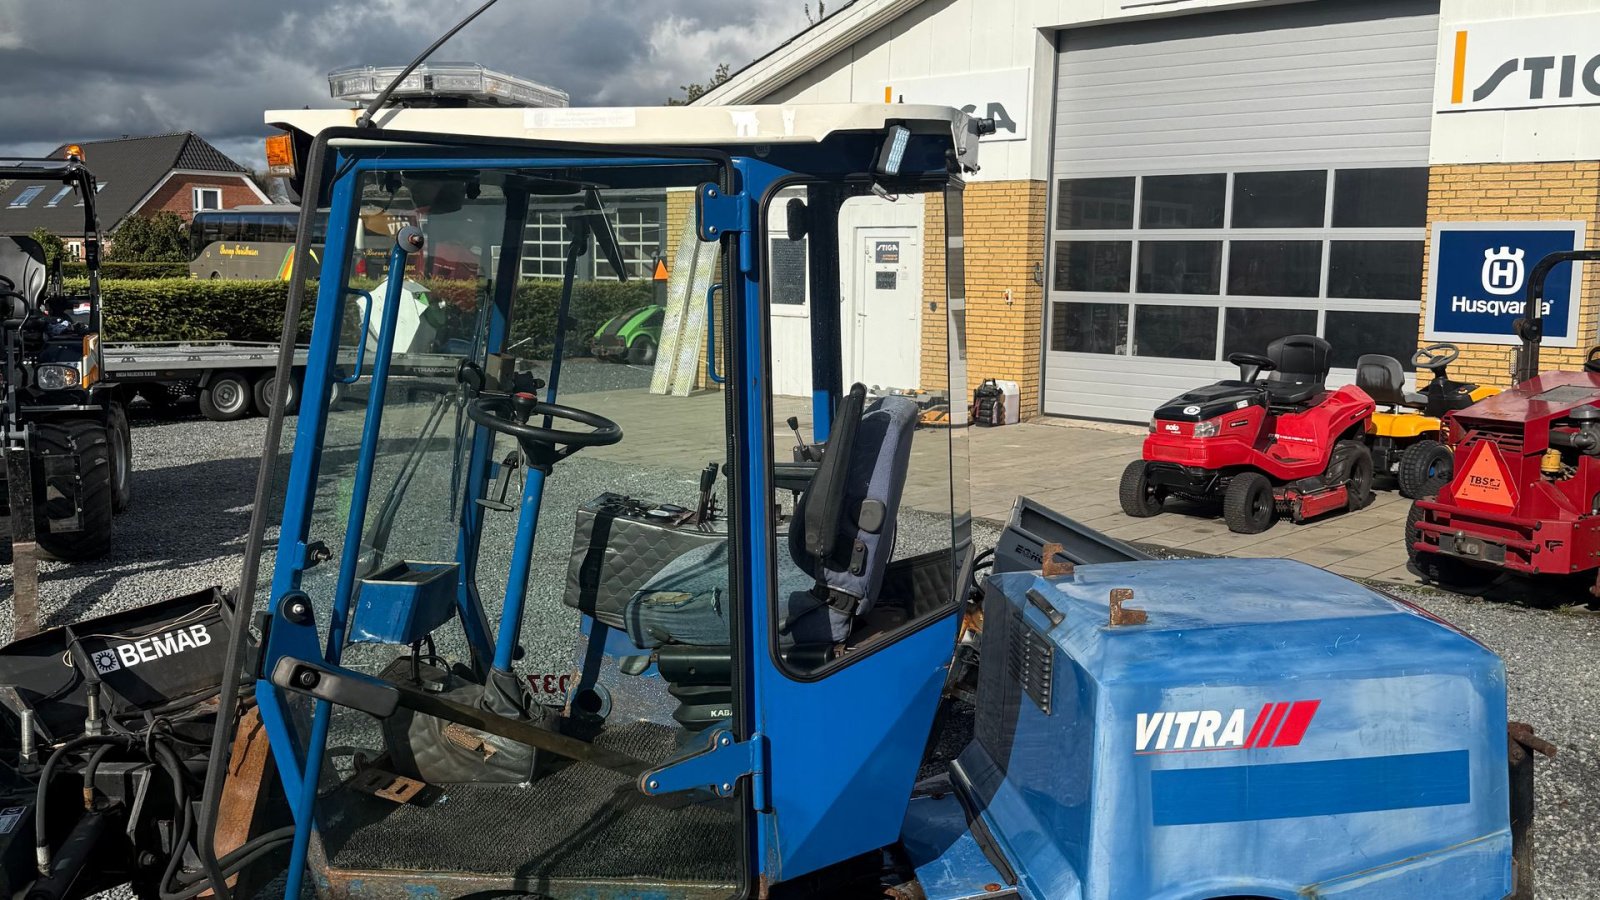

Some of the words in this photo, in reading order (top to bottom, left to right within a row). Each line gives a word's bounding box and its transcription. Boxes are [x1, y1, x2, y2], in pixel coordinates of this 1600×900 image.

[876, 244, 899, 252] STIGA
[1451, 295, 1551, 317] Husqvara
[1470, 475, 1489, 486] TBS
[116, 624, 212, 668] BEMAB
[710, 709, 733, 717] KAB
[1135, 708, 1245, 751] VITRA
